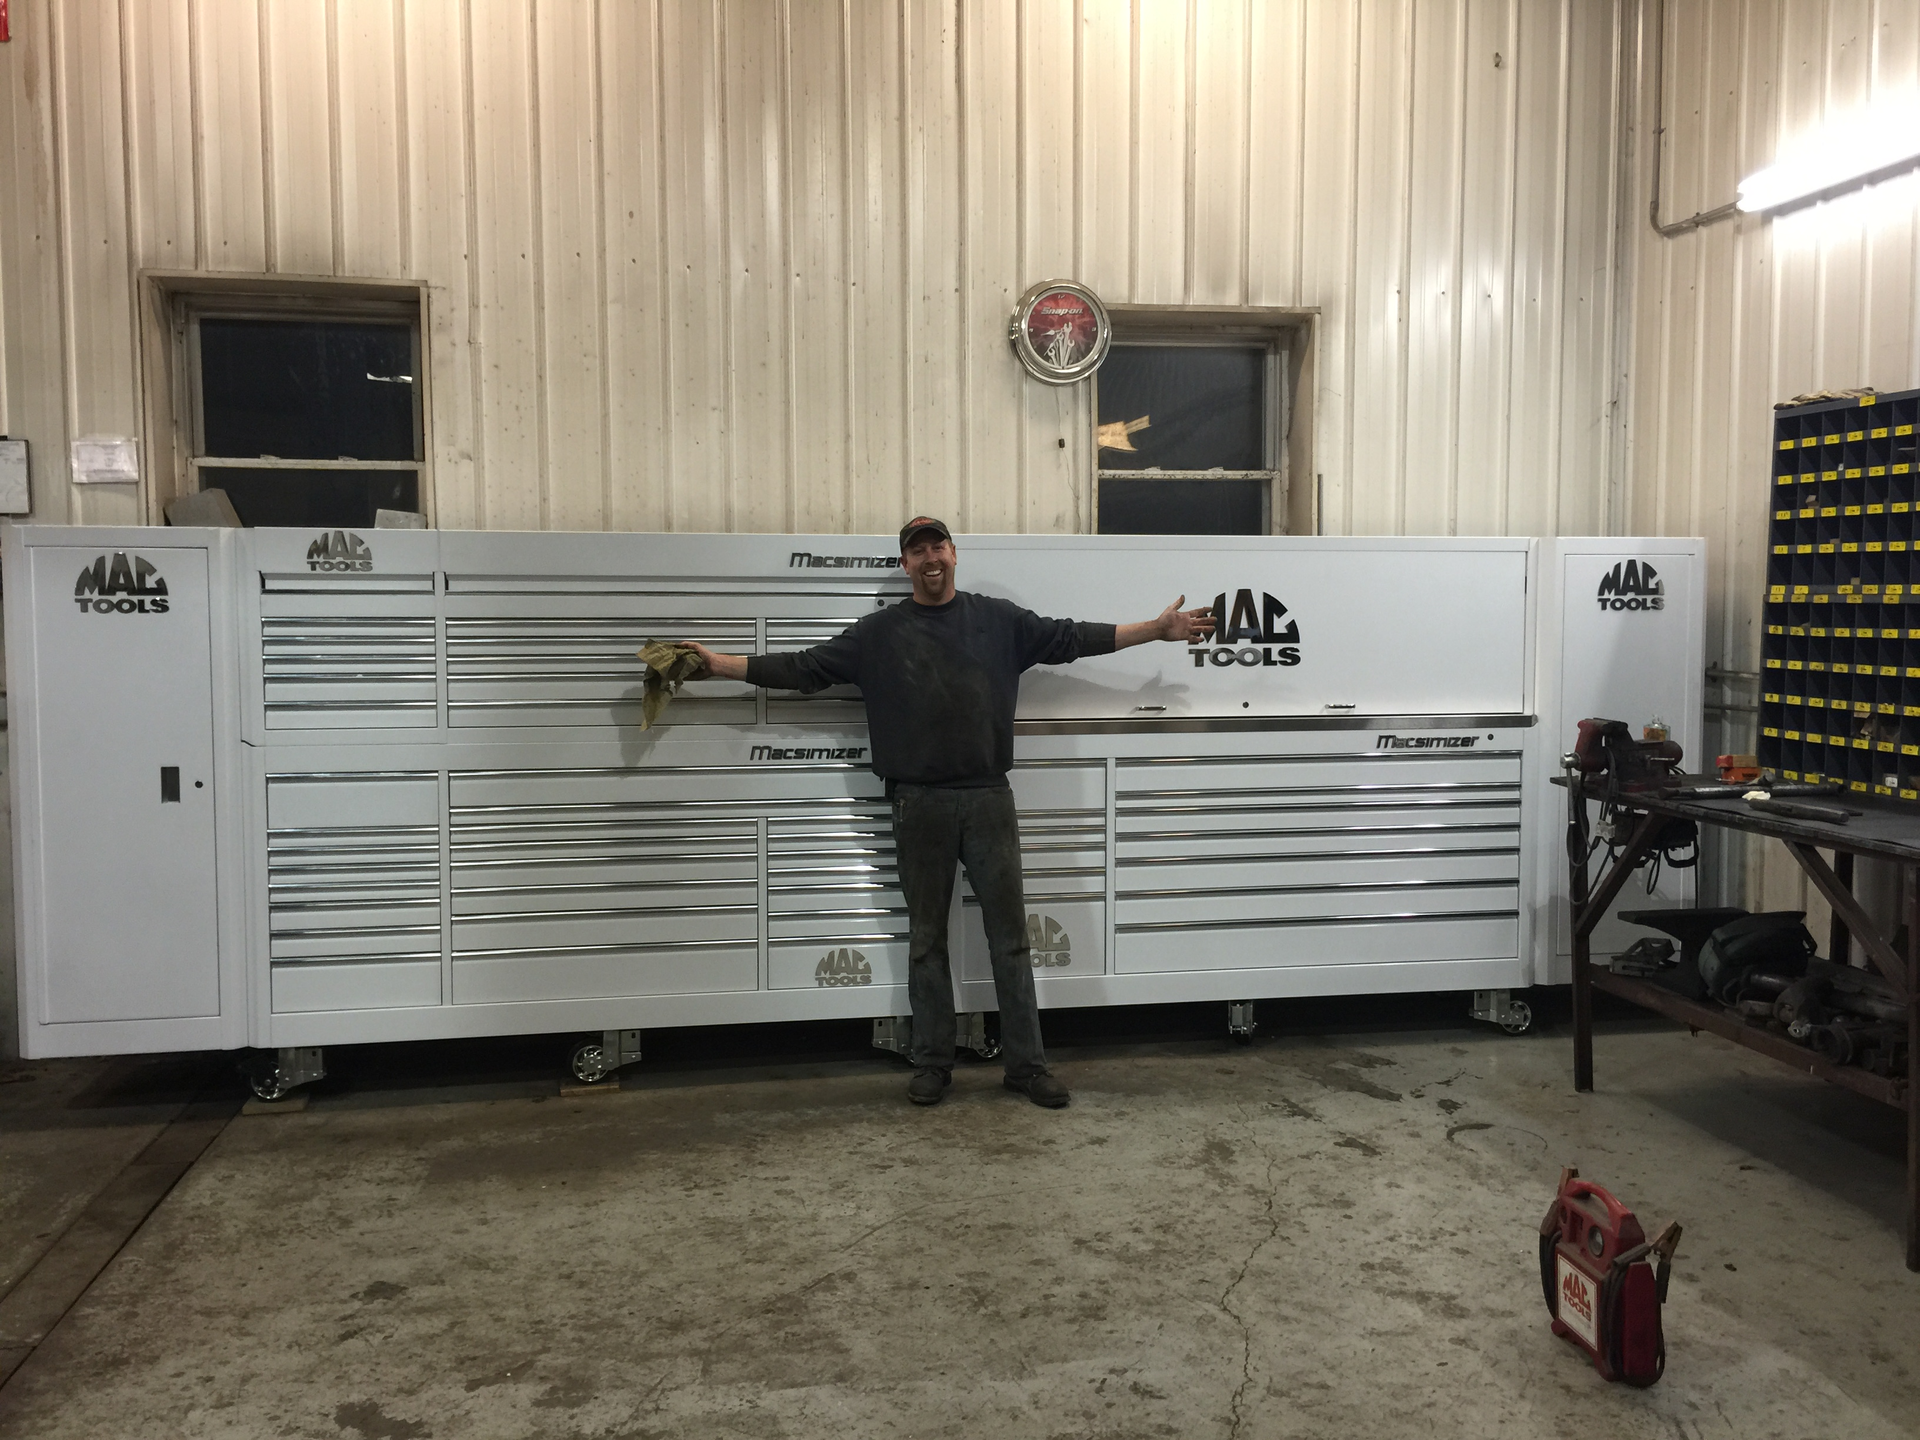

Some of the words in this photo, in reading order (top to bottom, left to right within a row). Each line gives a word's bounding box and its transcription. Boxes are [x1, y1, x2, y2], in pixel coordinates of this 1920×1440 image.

[1041, 306, 1083, 316] Snap-on
[307, 531, 372, 561] MAC
[74, 552, 169, 596] MAC
[307, 561, 373, 572] TOOLS
[1597, 559, 1665, 596] MAC
[74, 598, 170, 614] TOOLS
[1597, 597, 1665, 612] TOOLS
[1188, 588, 1300, 645] MAC
[1188, 647, 1301, 668] TOOLS
[1376, 734, 1480, 749] Macsimizer
[749, 745, 868, 760] Macsimizer
[1026, 913, 1071, 951] AC
[814, 948, 872, 976] MAC
[1030, 952, 1072, 968] OLS
[814, 975, 872, 987] TOOLS
[1563, 1272, 1592, 1313] MAC
[1563, 1291, 1592, 1322] TOOLS
